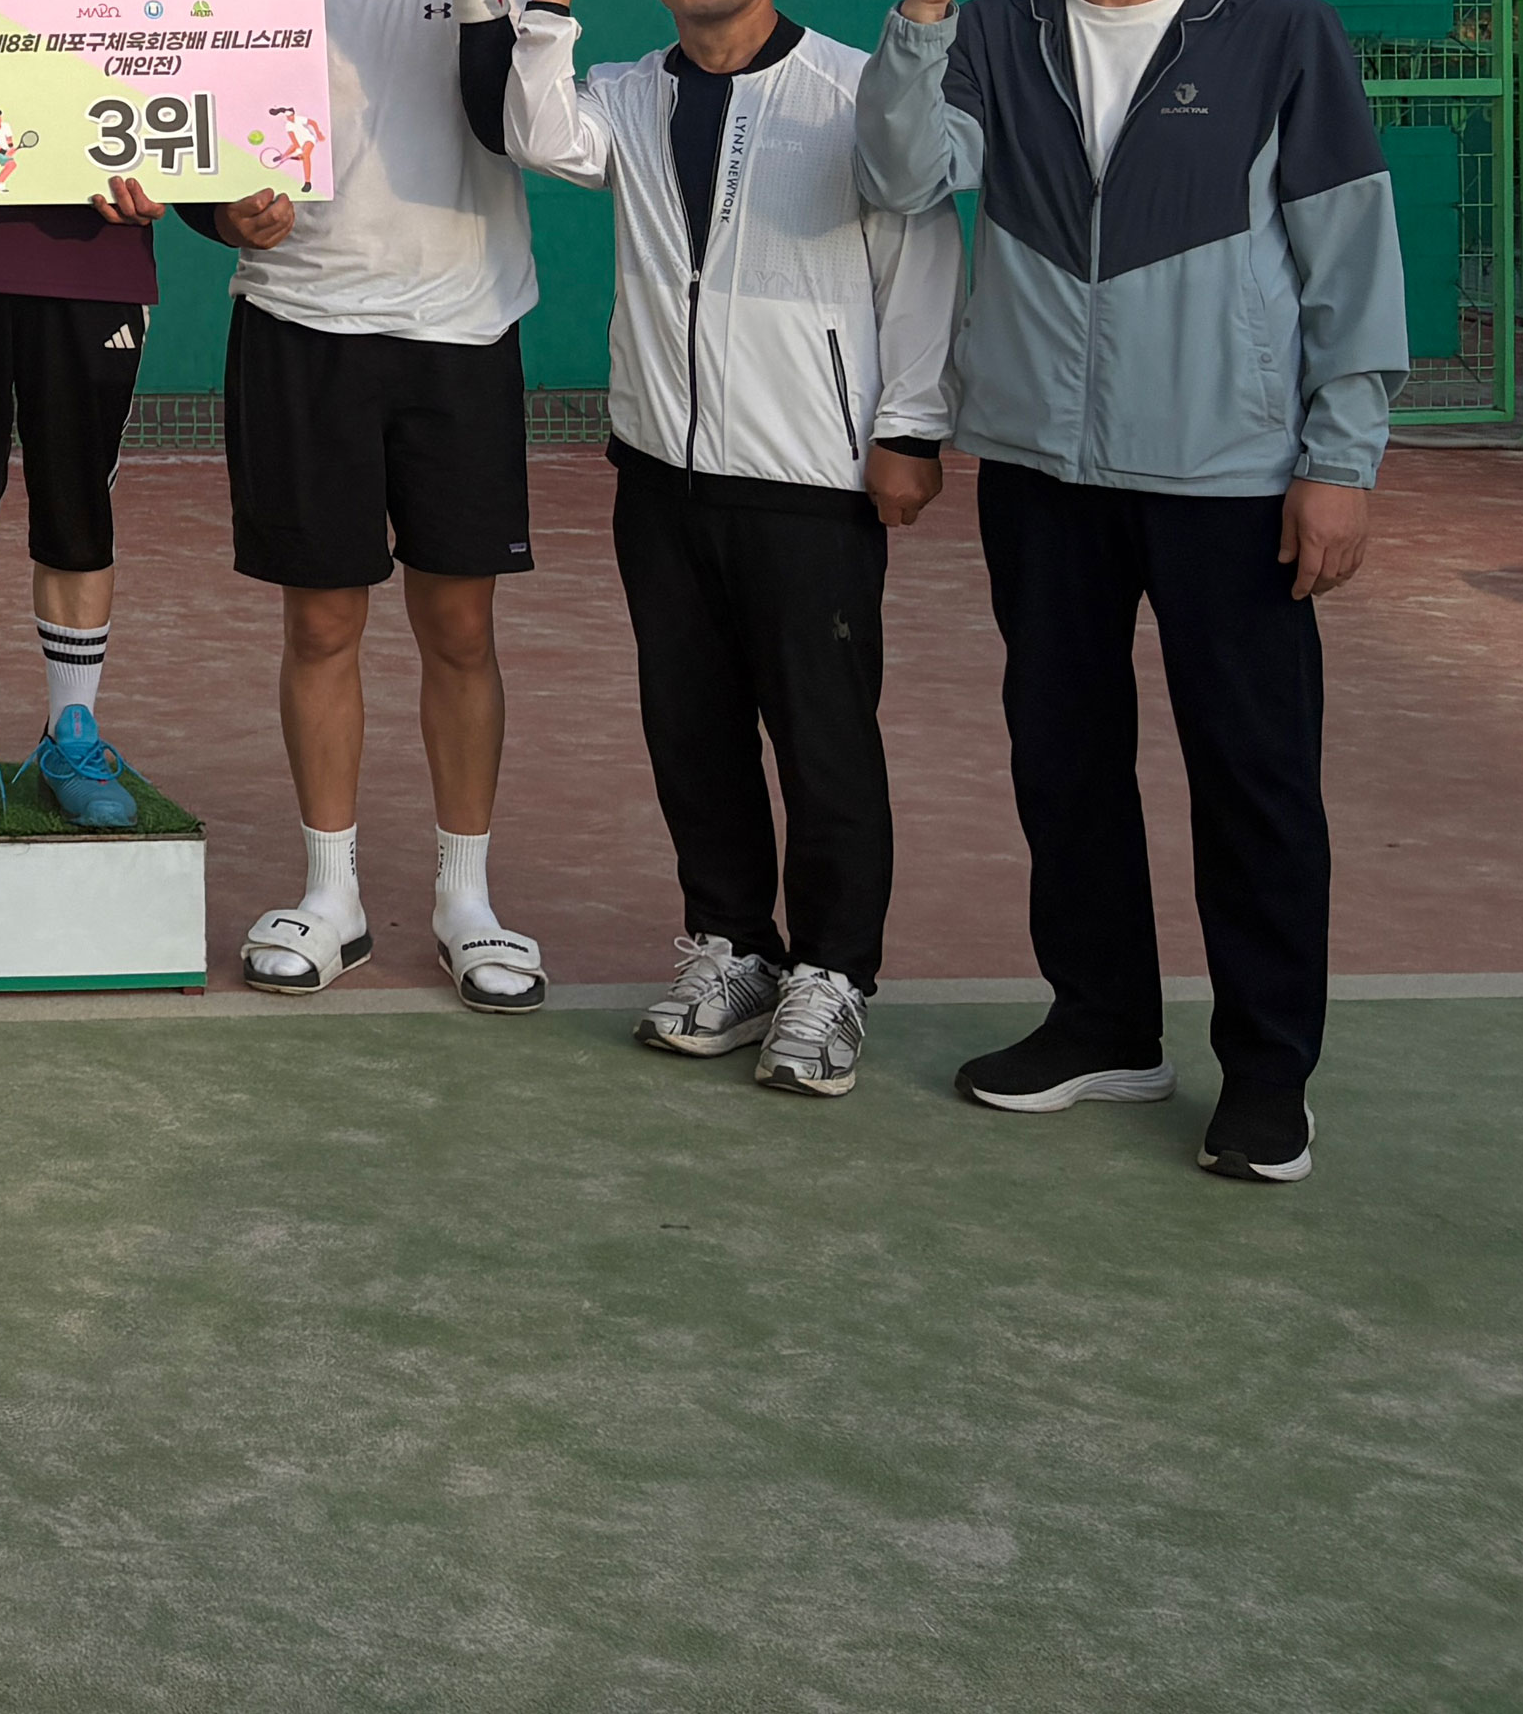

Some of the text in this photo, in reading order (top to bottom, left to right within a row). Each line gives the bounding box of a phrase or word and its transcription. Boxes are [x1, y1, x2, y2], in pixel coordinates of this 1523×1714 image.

[45, 30, 206, 52] 마포구체육회장배
[210, 28, 313, 51] 테니스대회
[103, 54, 182, 76] (개인전)
[87, 93, 211, 170] 3위
[720, 116, 747, 224] LYNX NEWYORK
